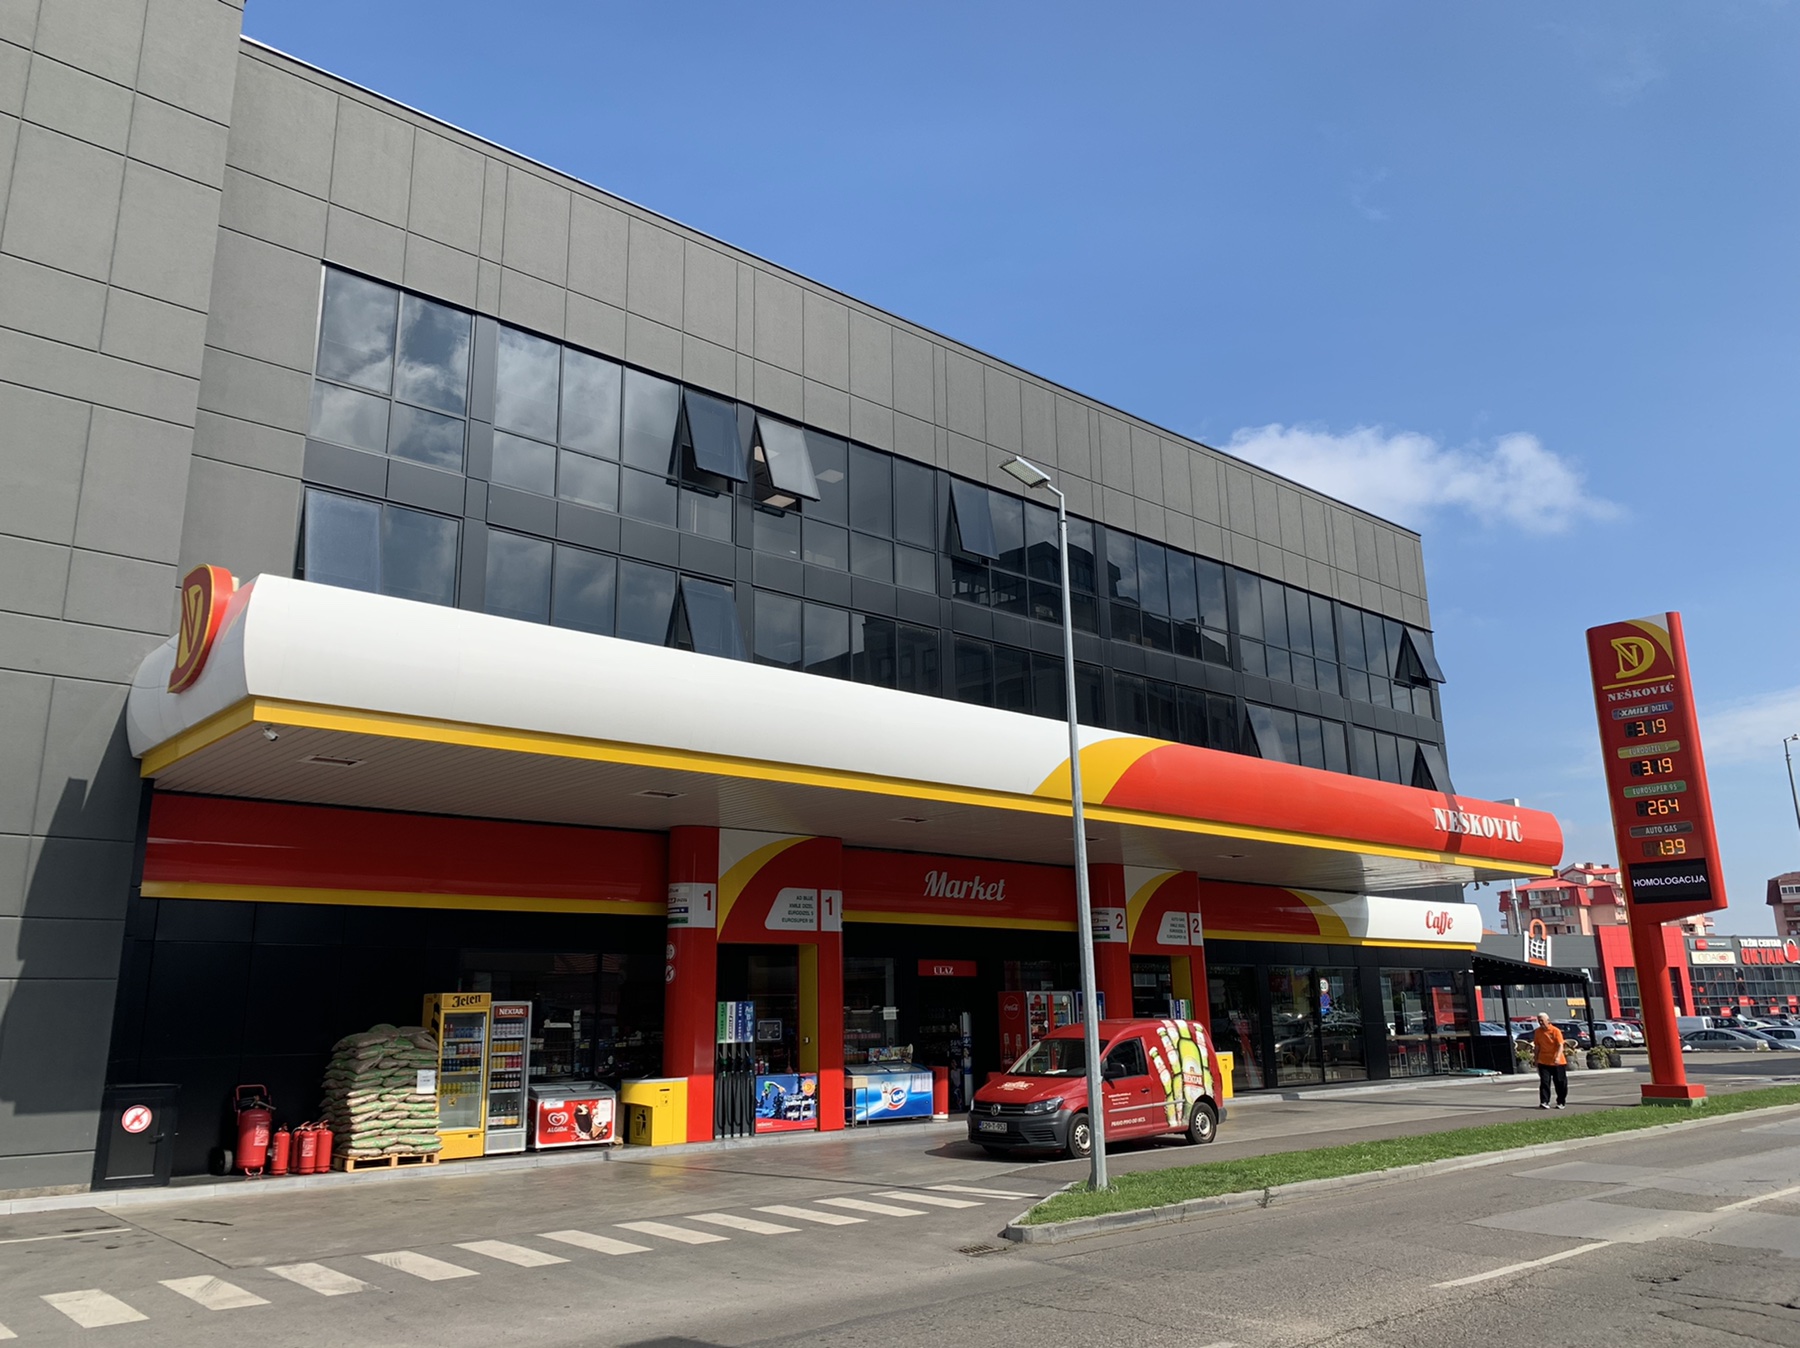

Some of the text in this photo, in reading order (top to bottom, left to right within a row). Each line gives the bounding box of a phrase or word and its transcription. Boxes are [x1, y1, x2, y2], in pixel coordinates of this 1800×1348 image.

[1607, 682, 1674, 702] NEŠKOVIĆ
[1651, 703, 1668, 712] DIZEL
[1636, 718, 1667, 736] 3.19
[1629, 744, 1661, 755] EURODIZEL
[1641, 757, 1673, 776] 3.19
[1632, 784, 1667, 795] EUROSUPER
[1432, 805, 1523, 843] NEŠKOVIĆ
[1645, 824, 1677, 835] AUTO GAS
[923, 870, 1006, 901] Market
[1633, 874, 1706, 887] HOMOLOGACIJA
[703, 890, 712, 911] 1
[825, 896, 833, 916] 1
[1115, 913, 1124, 930] 2
[1192, 918, 1200, 933] 2
[1425, 910, 1454, 935] Caffe
[1741, 948, 1785, 965] OKTAN
[933, 966, 954, 975] ULAZ
[452, 994, 482, 1008] Jelen
